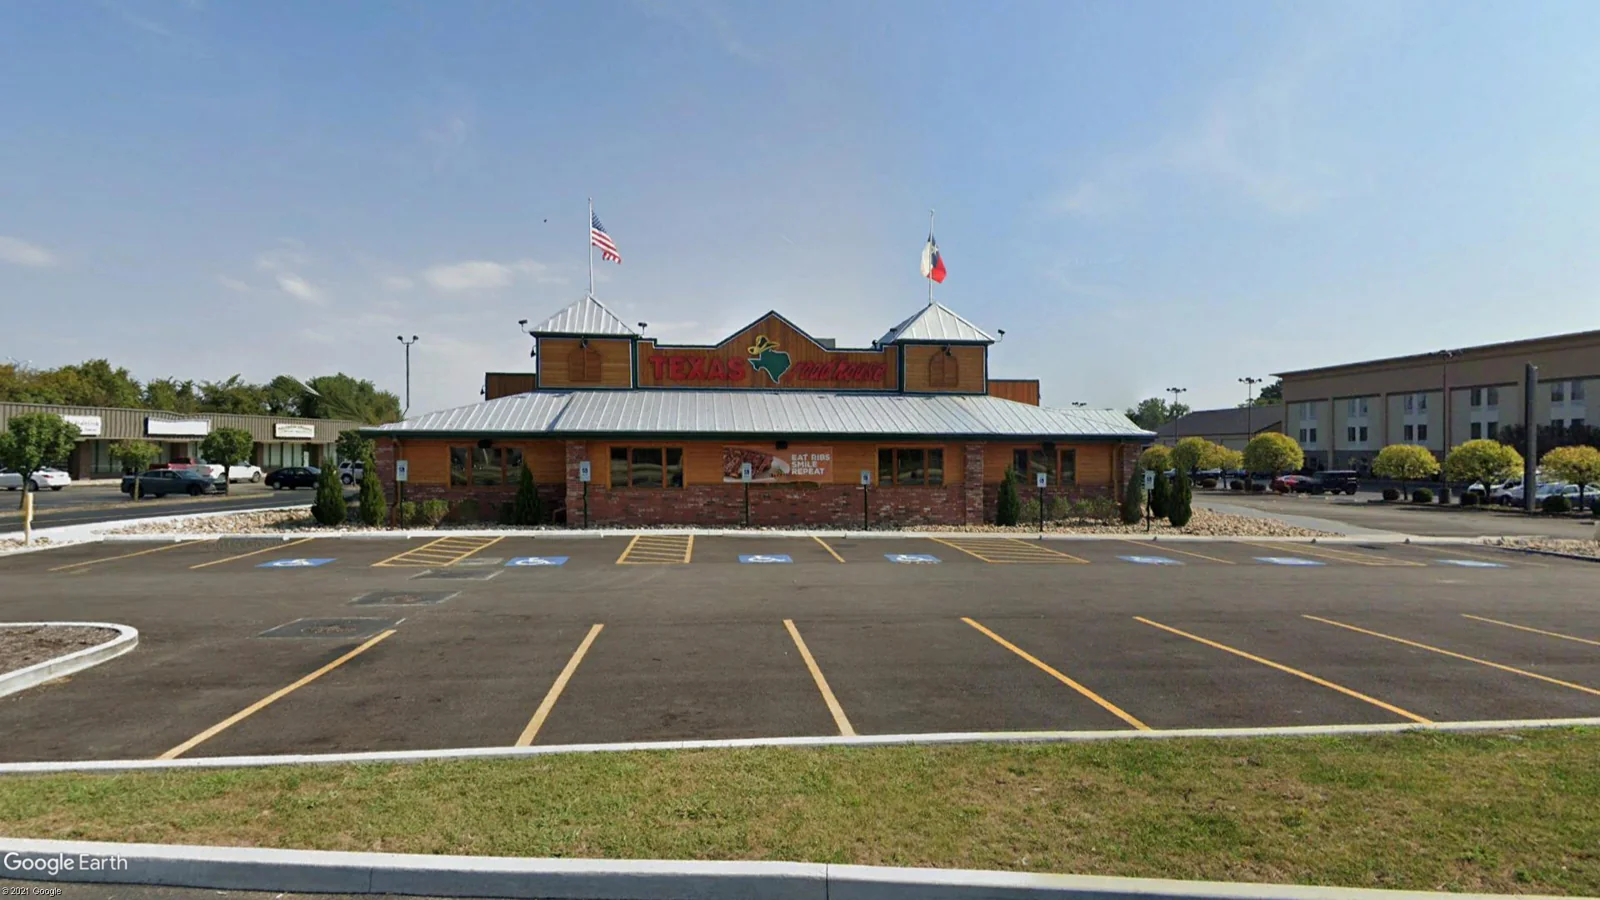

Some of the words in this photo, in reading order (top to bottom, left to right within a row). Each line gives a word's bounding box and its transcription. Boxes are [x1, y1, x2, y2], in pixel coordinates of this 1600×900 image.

[648, 355, 746, 381] TEXAS
[791, 453, 808, 461] EAT
[811, 453, 831, 461] RIBS
[791, 460, 817, 468] SMILE
[791, 467, 825, 475] REPEAT
